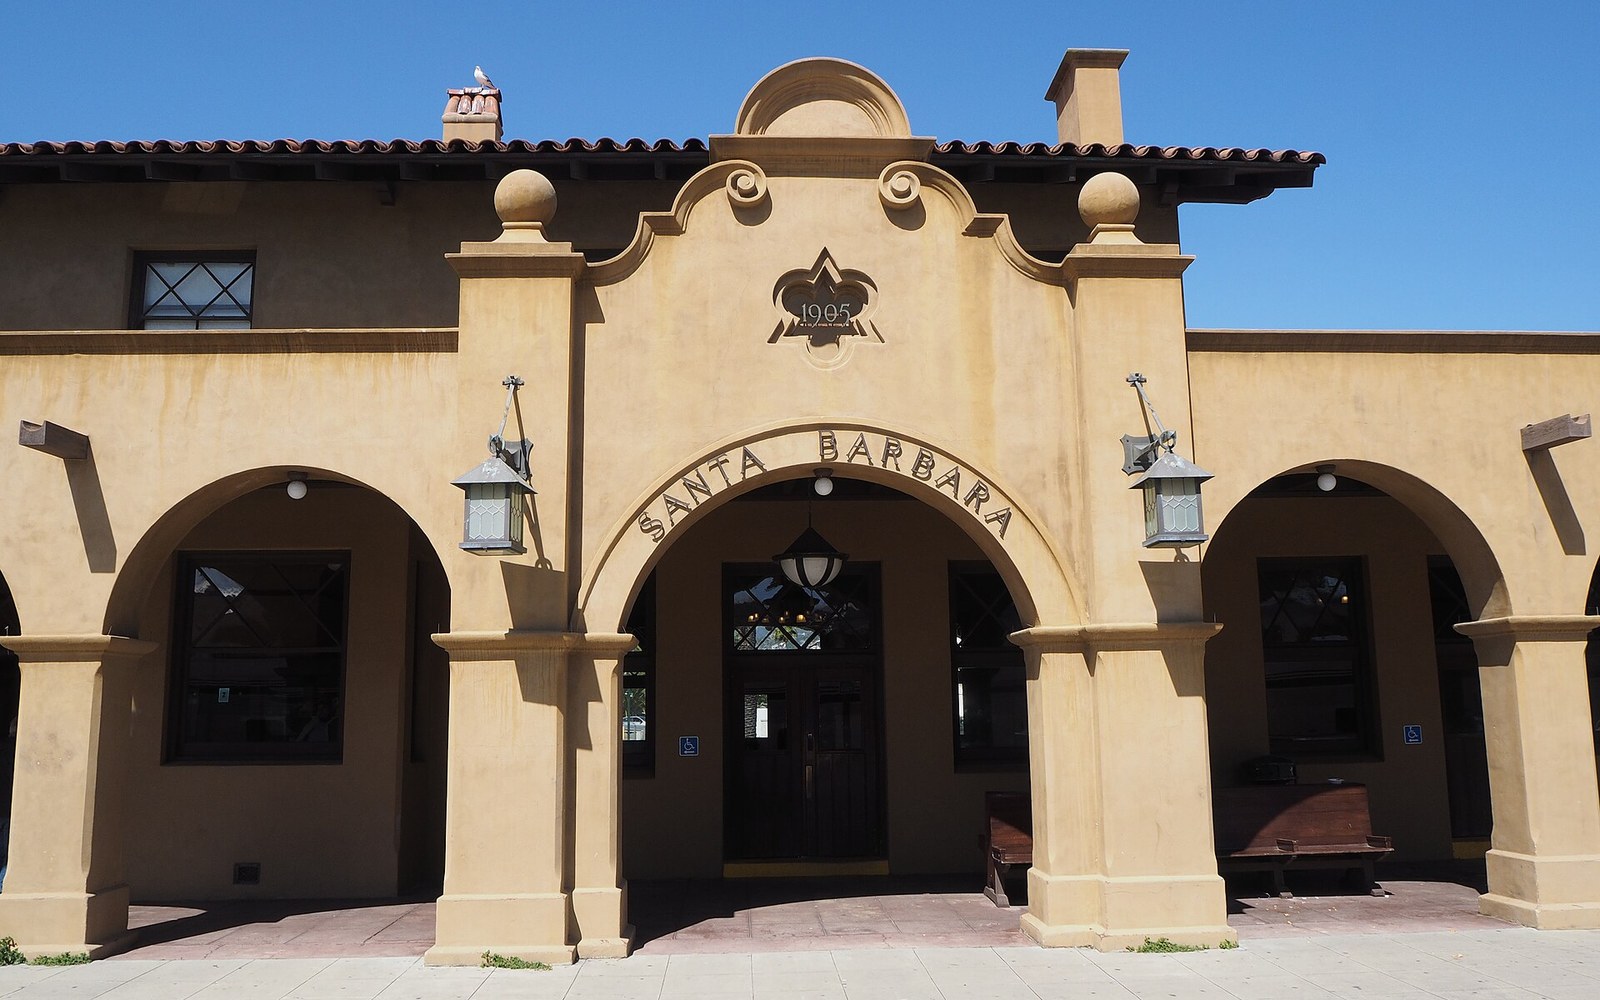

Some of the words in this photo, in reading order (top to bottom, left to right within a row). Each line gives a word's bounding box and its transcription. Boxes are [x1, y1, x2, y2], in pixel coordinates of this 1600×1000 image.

[801, 303, 850, 328] 1905
[638, 445, 767, 543] SANTA
[818, 430, 1012, 539] BARBARA
